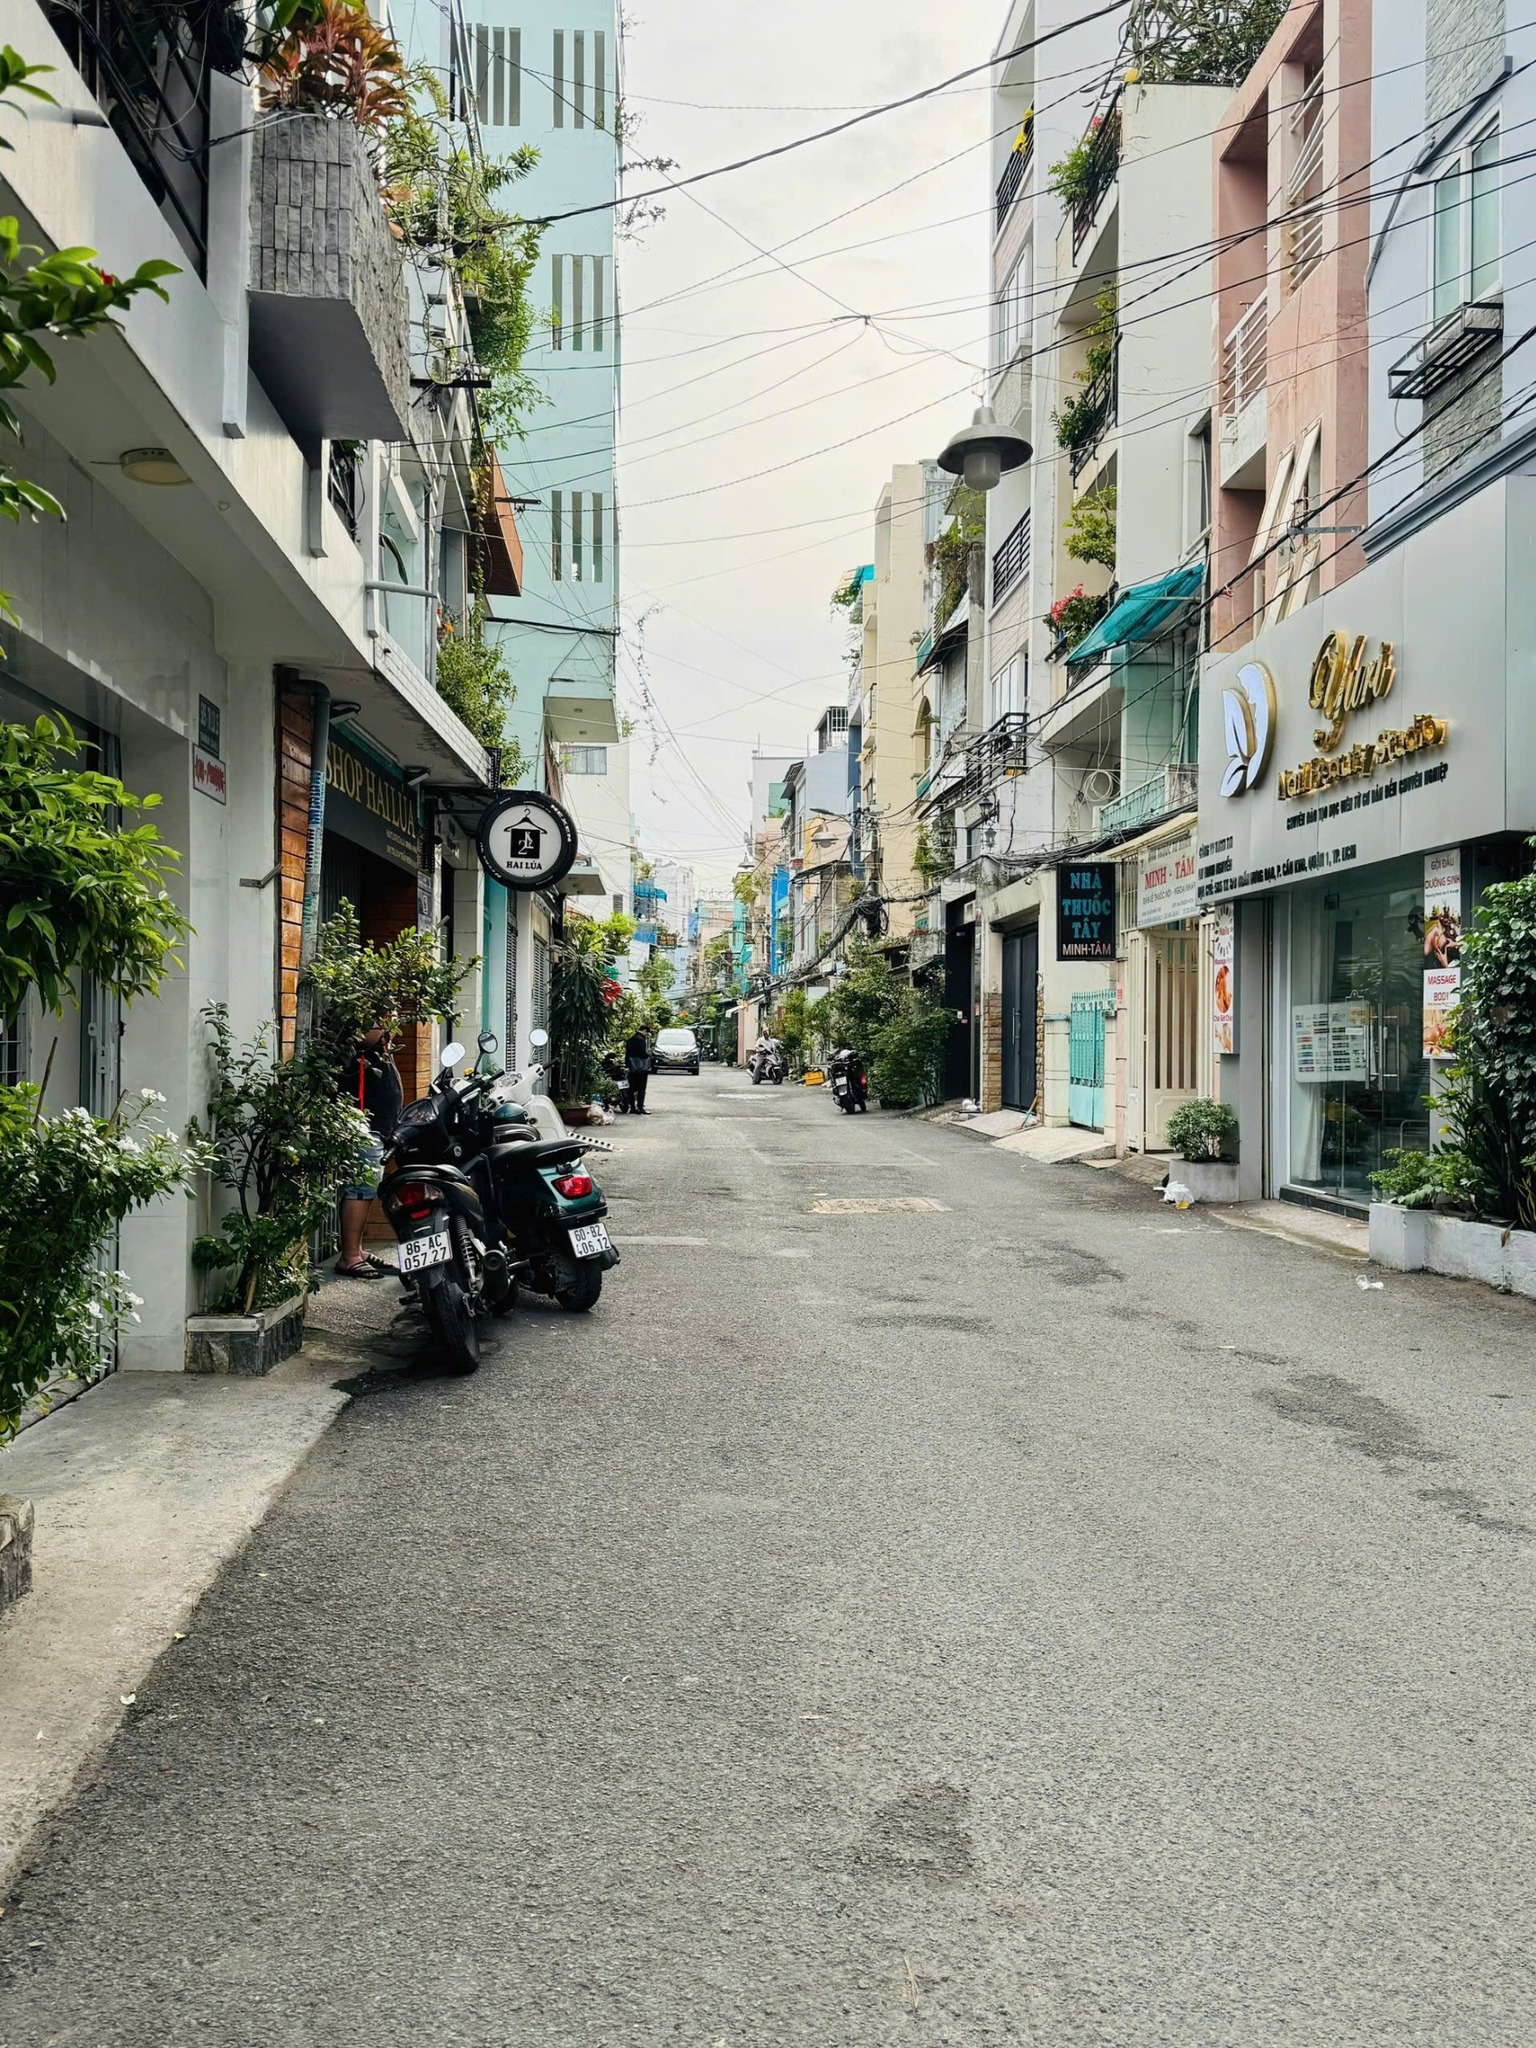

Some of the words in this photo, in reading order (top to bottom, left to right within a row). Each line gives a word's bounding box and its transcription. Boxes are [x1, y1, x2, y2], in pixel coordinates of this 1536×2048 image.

[326, 740, 362, 802] SHOP
[365, 767, 391, 822] HAI
[550, 804, 572, 843] NEXEN
[506, 861, 523, 869] HAI
[1145, 866, 1167, 890] MINH
[1175, 855, 1195, 880] TÂM
[1070, 868, 1102, 889] NHÀ
[1447, 874, 1460, 886] SINH
[1062, 891, 1111, 916] THUỐC
[1072, 917, 1101, 939] TÂY
[1062, 940, 1111, 956] MINH-TÂM
[1427, 974, 1457, 985] MASSAGE
[574, 1225, 602, 1242] 60-B2
[406, 1234, 442, 1256] 86-AC
[404, 1247, 446, 1271] 057.27
